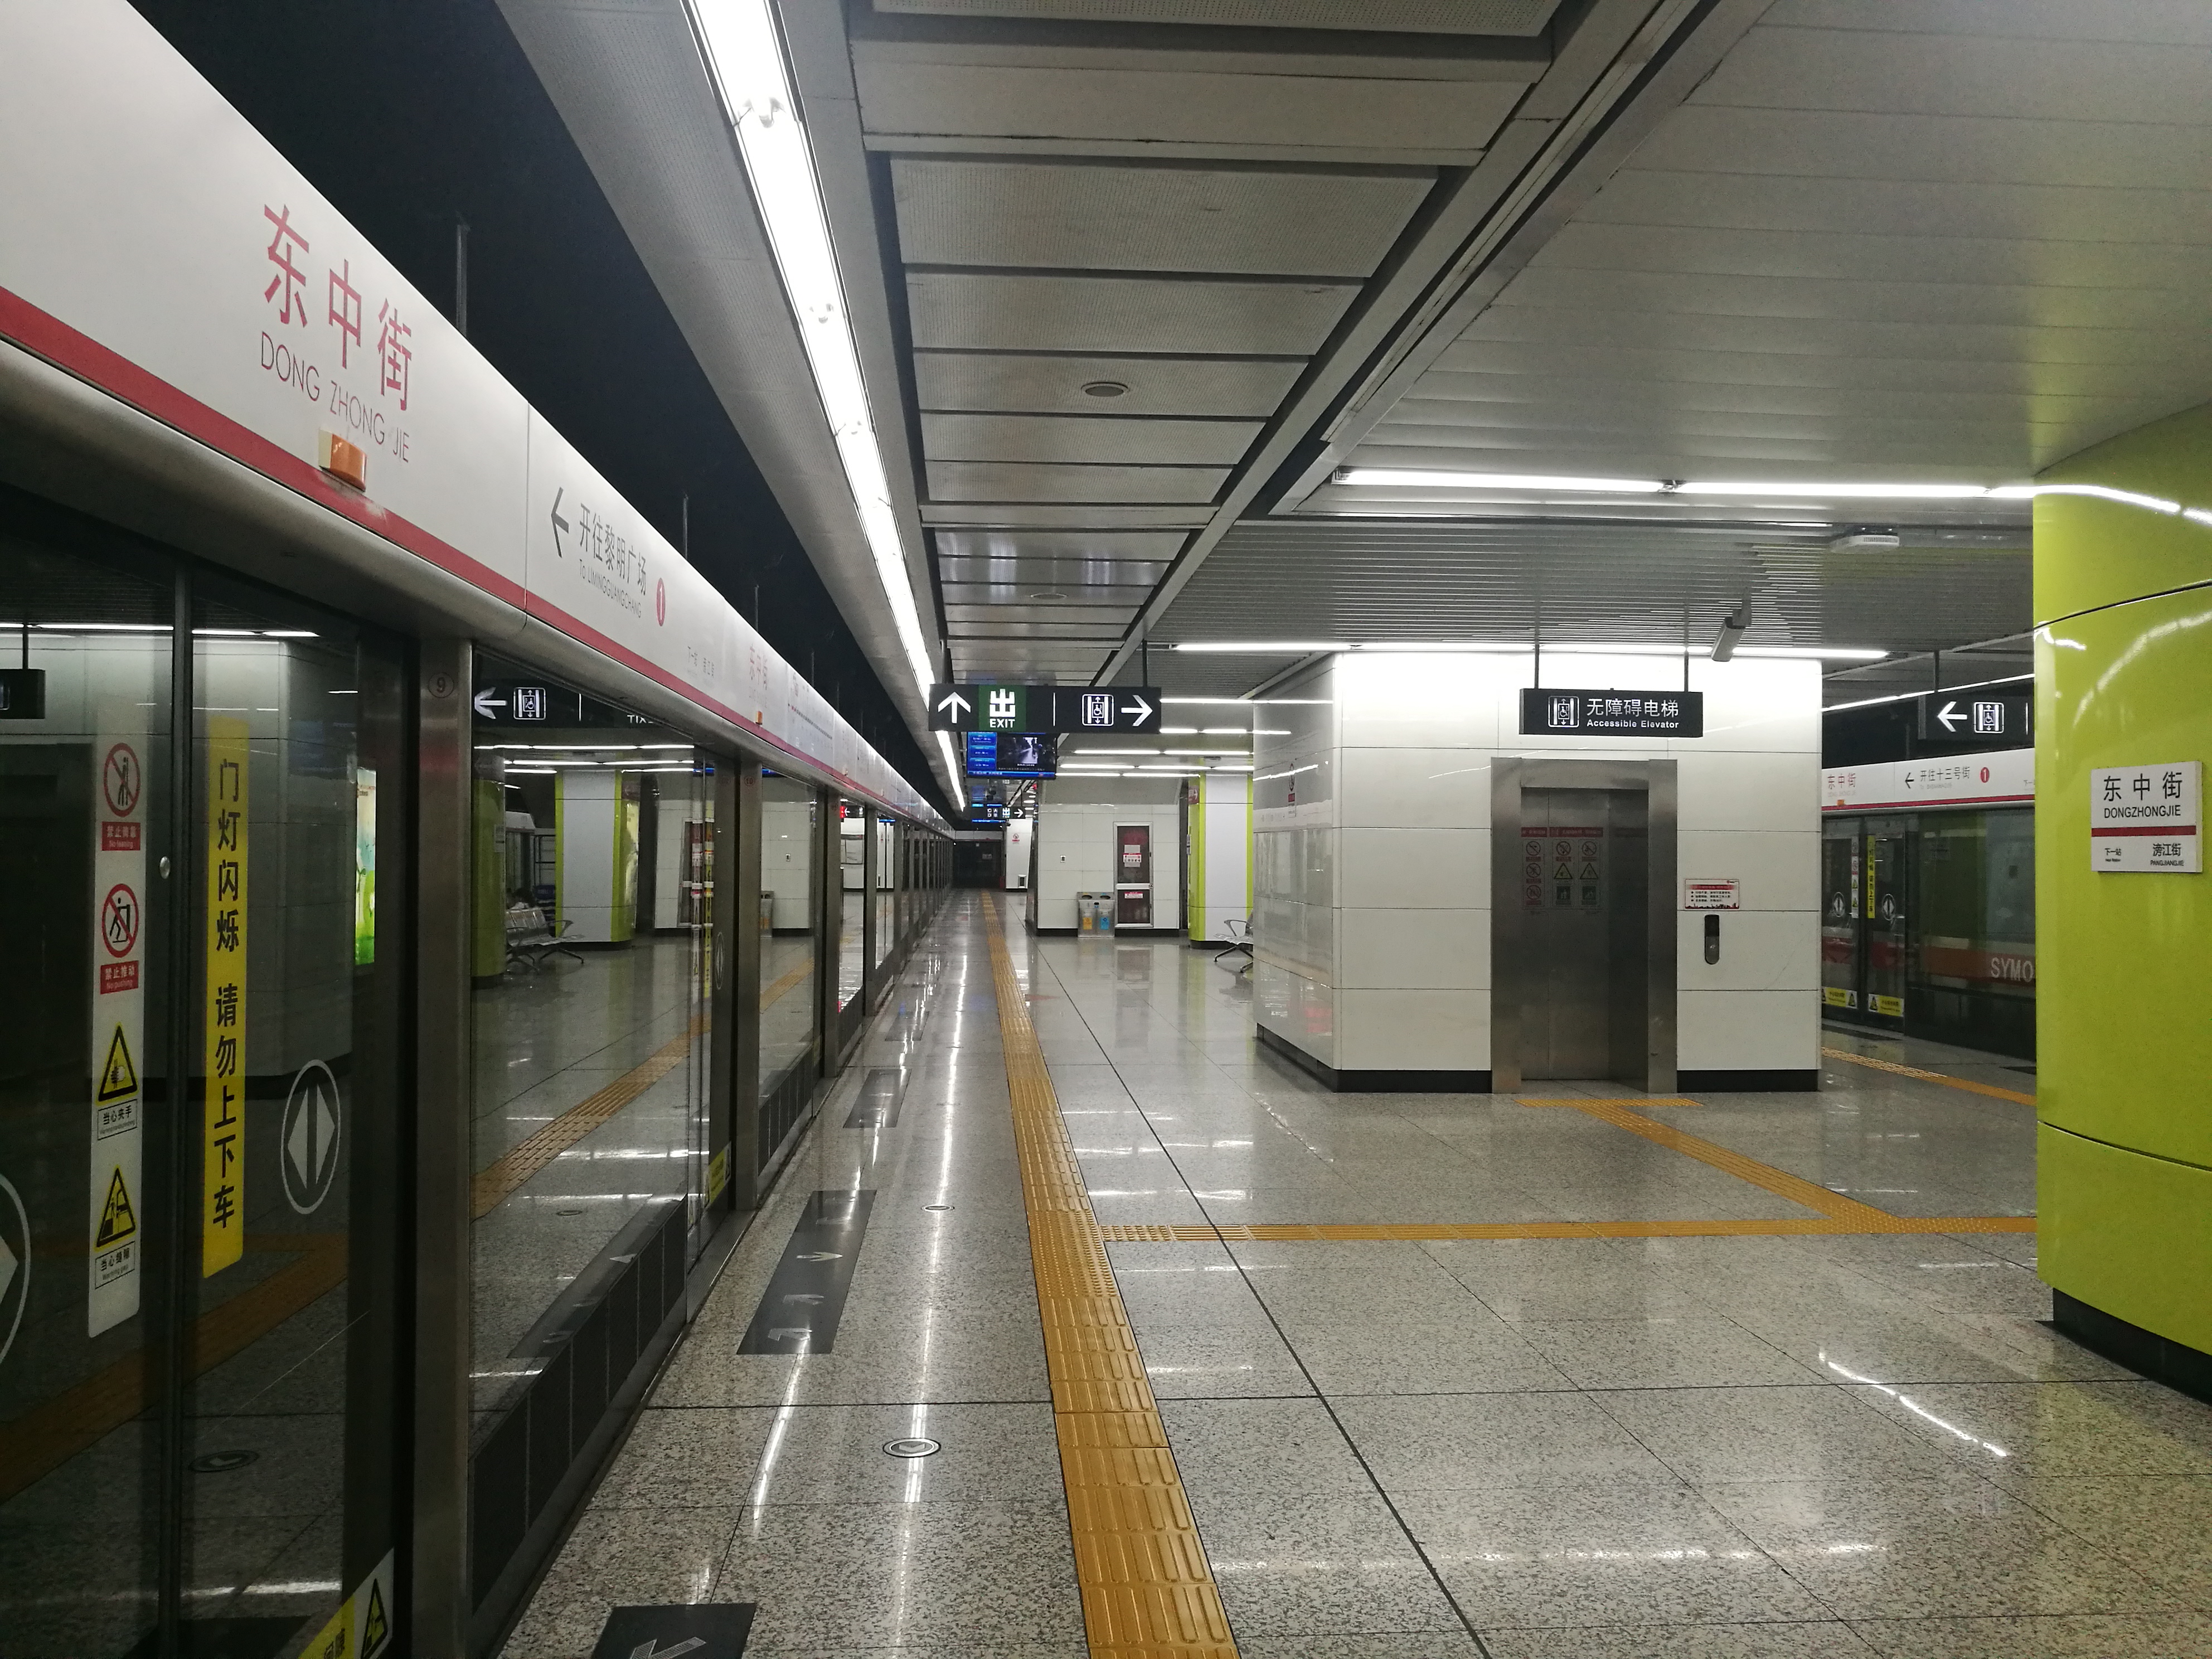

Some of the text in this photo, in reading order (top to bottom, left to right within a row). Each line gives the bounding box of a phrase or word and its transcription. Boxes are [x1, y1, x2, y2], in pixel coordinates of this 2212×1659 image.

[264, 204, 411, 411] 东中街
[261, 331, 409, 463] DONG ZHONG JIE
[579, 503, 646, 596] 开往黎明广场
[580, 559, 586, 579] To
[989, 688, 1016, 717] 出
[1587, 698, 1679, 717] 无障碍电梯
[989, 719, 1015, 728] EXIT
[1587, 719, 1637, 727] Accessible
[1828, 773, 1856, 789] 东中街
[1920, 766, 1971, 782] 开往十三号街
[2104, 771, 2182, 802] 东中街
[2104, 804, 2181, 818] DONGZHONGJIE
[2105, 848, 2122, 856] 下一站
[212, 759, 241, 1229] 门灯闪烁 请勿上下车
[103, 1105, 132, 1125] 当心夹手
